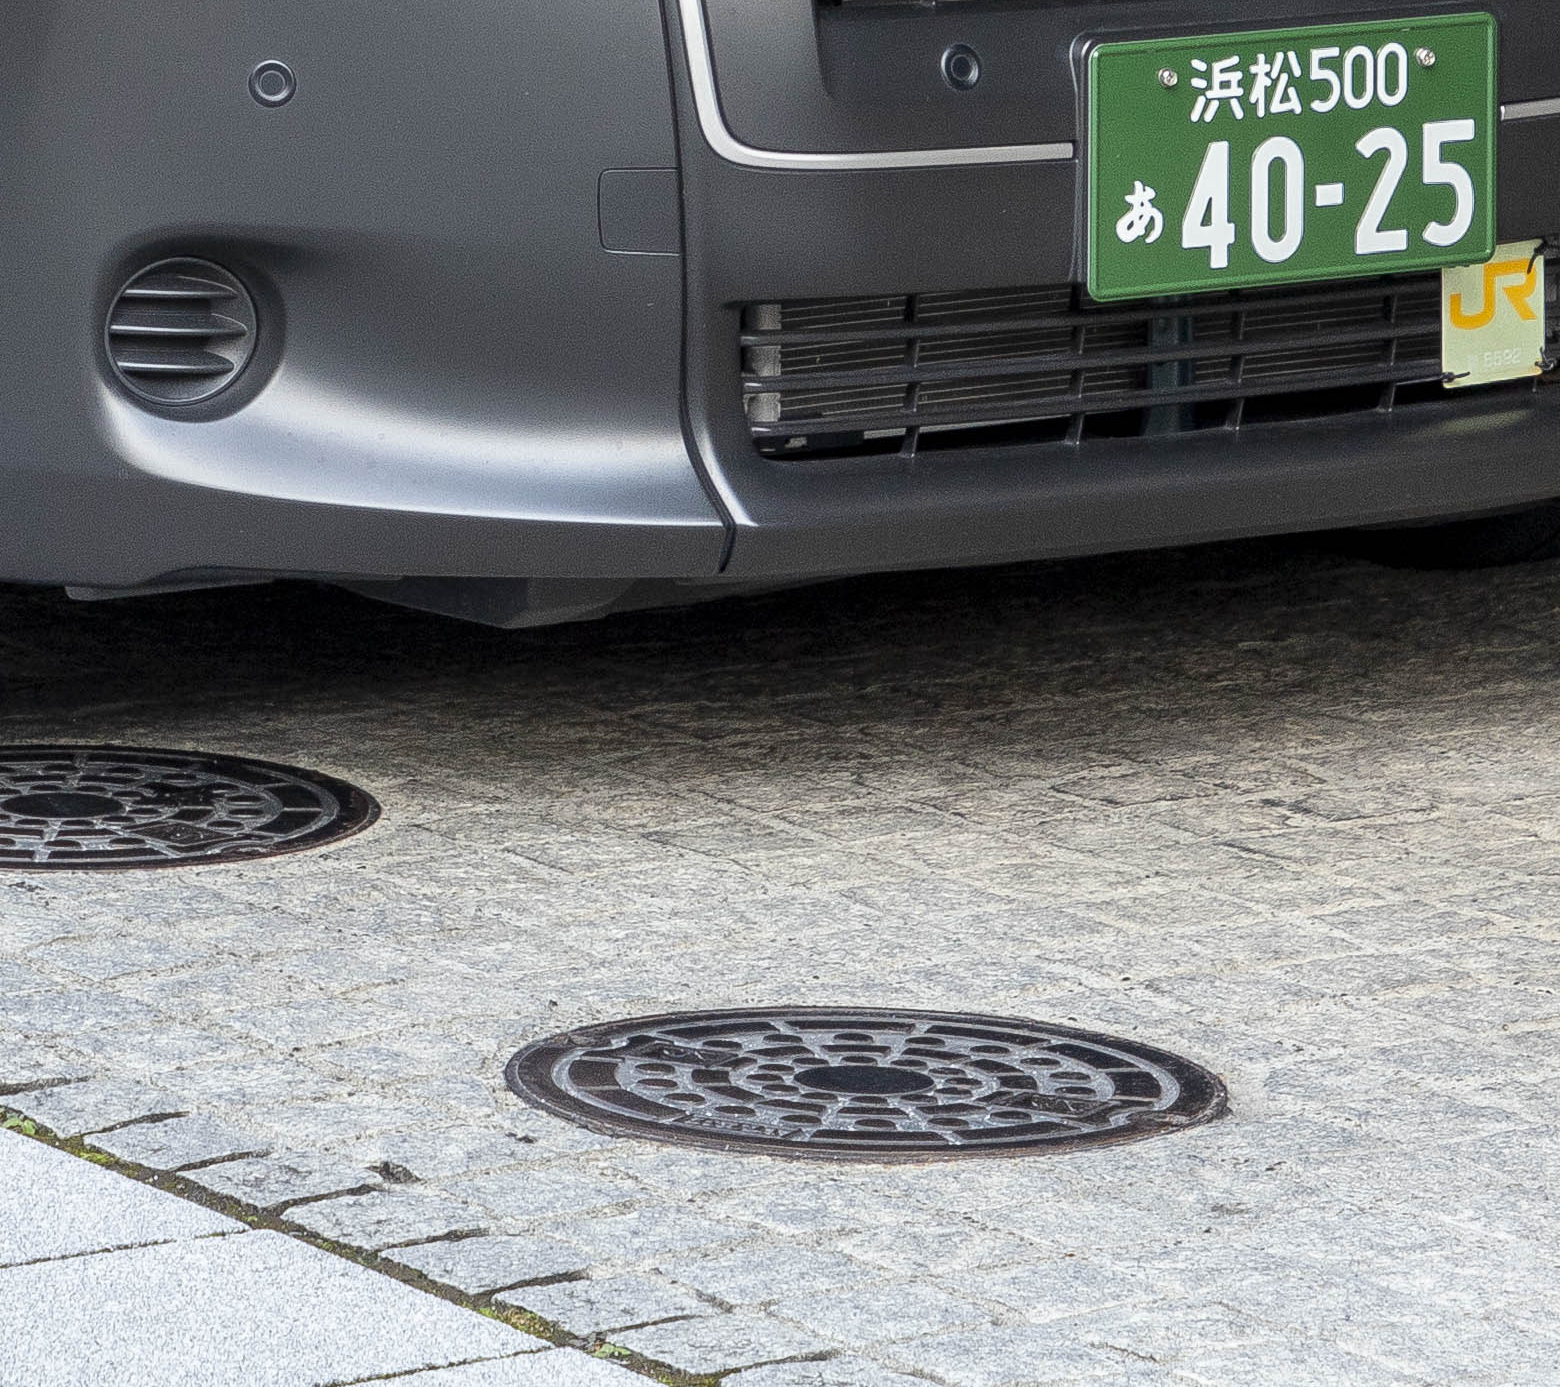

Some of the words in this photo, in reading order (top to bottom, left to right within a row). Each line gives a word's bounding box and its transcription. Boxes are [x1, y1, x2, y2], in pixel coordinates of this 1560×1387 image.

[1115, 180, 1164, 245] あ
[1181, 119, 1476, 270] 40-25
[1449, 258, 1538, 330] JR
